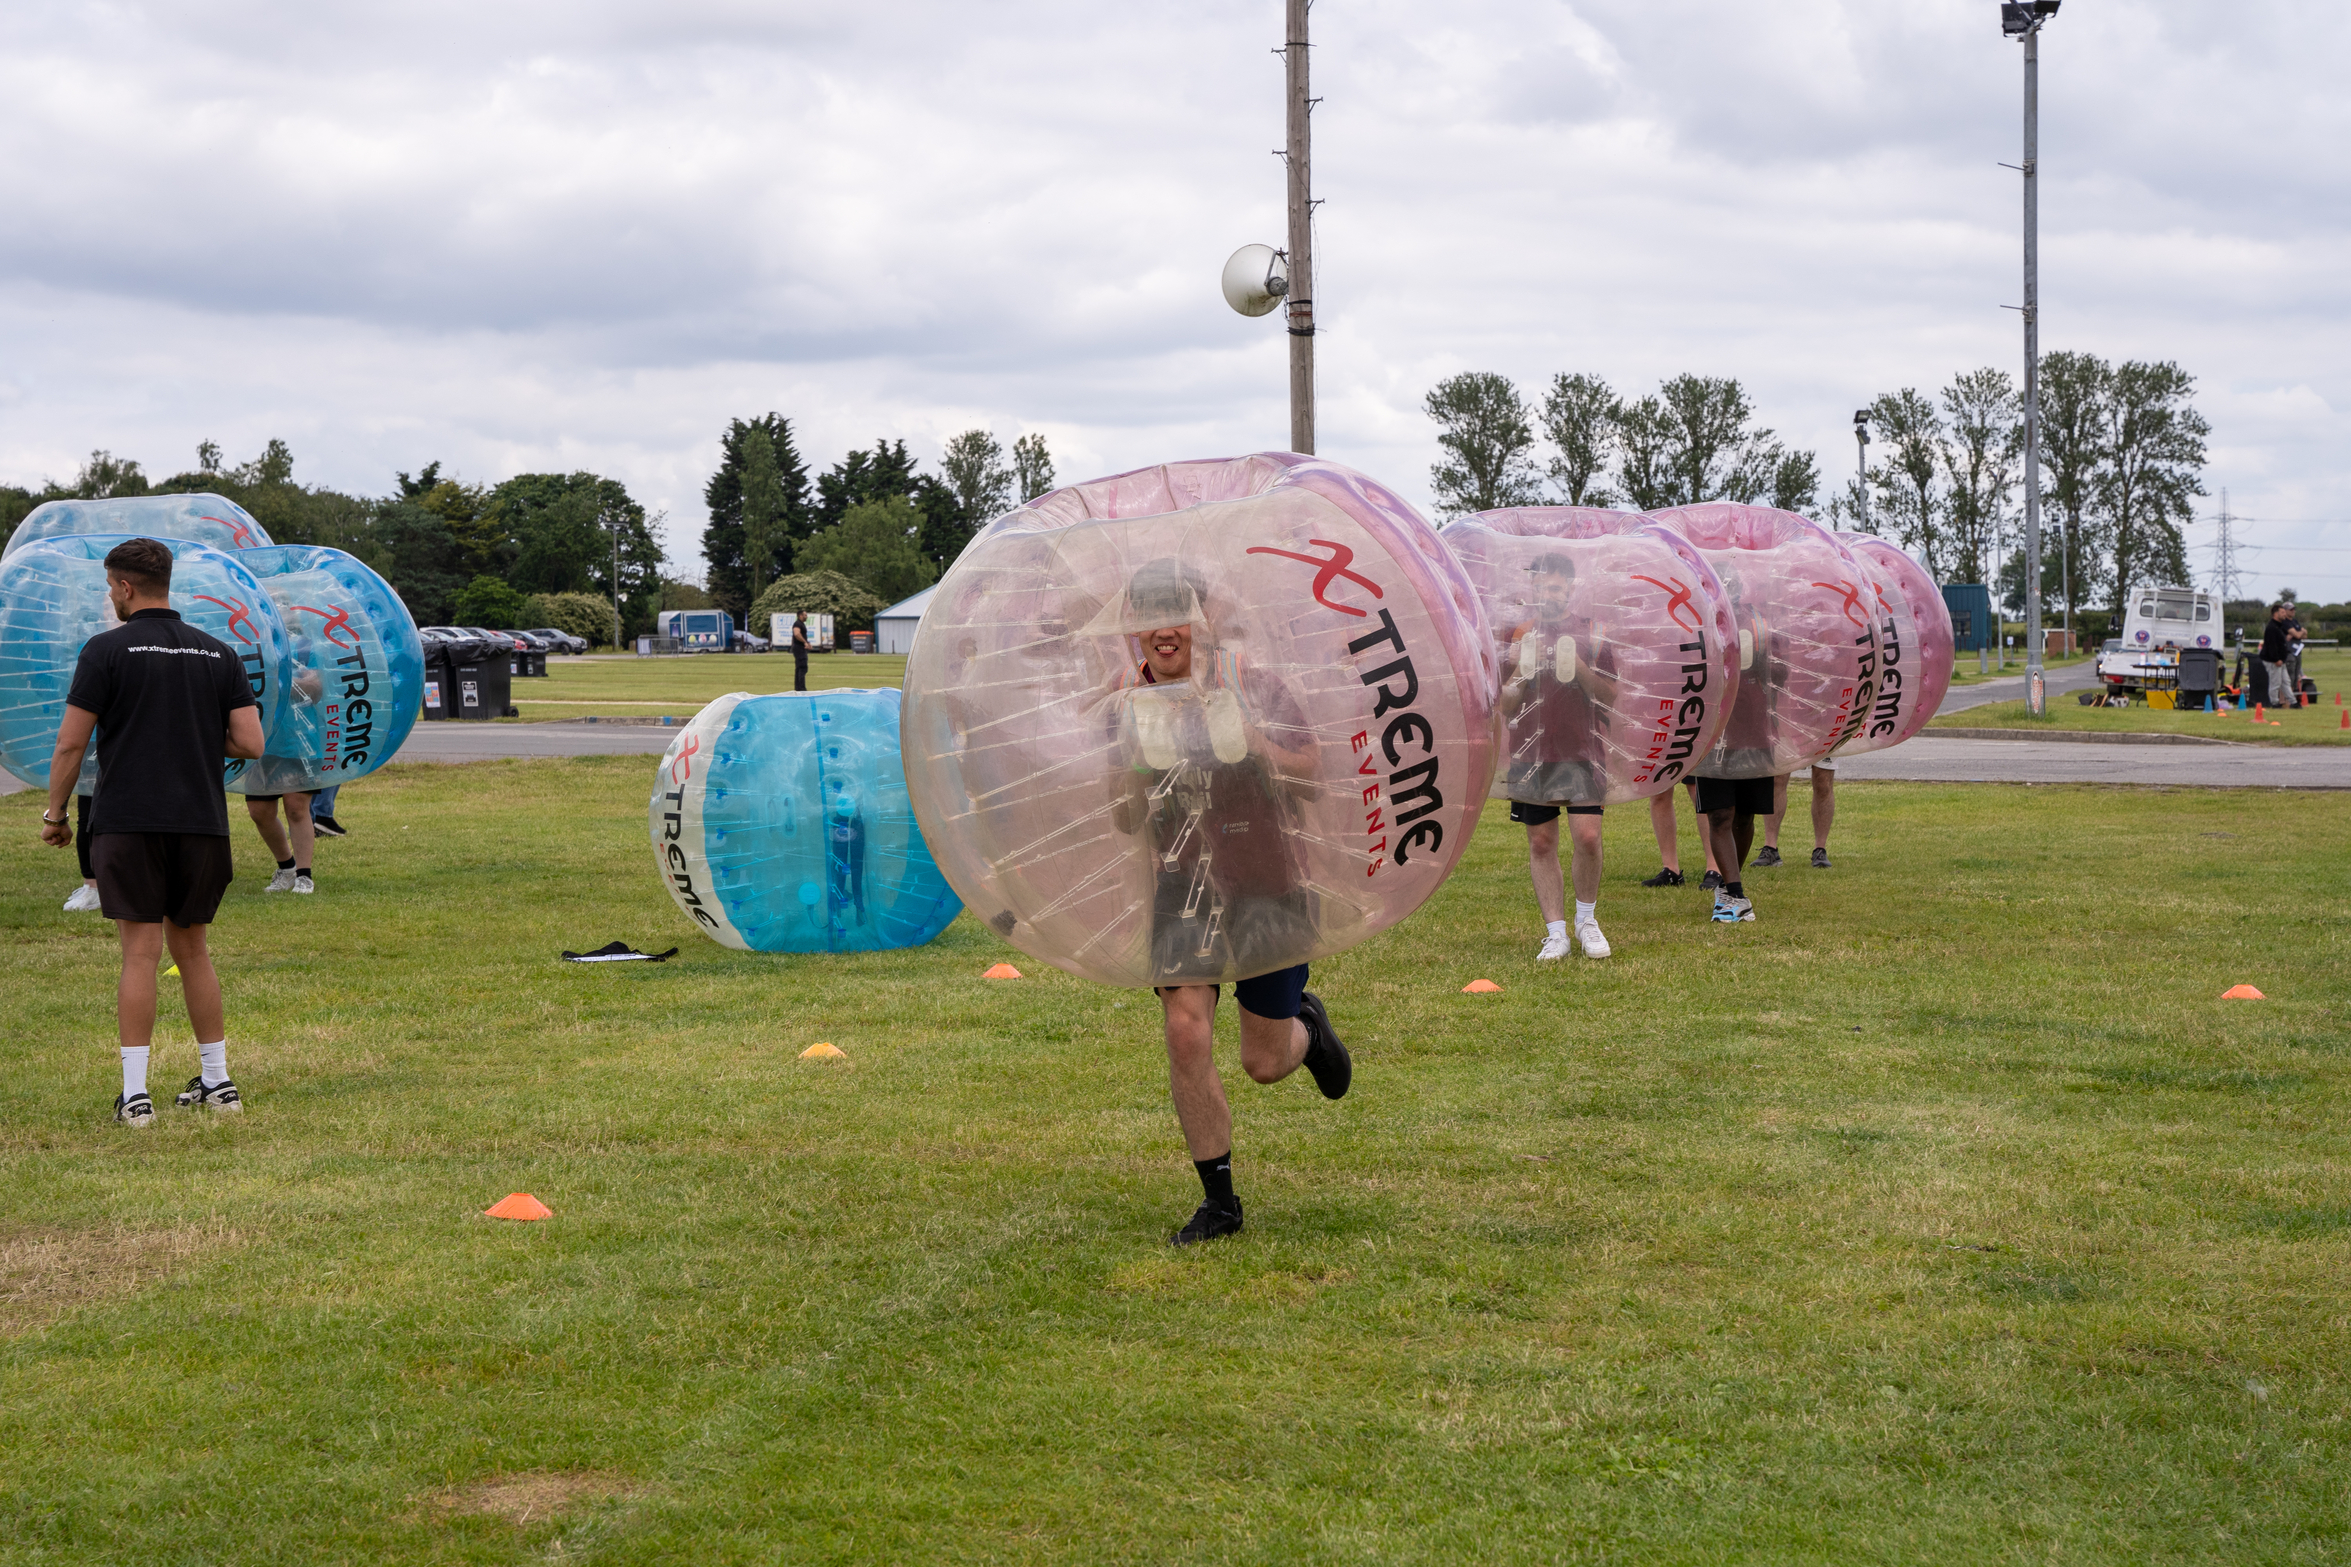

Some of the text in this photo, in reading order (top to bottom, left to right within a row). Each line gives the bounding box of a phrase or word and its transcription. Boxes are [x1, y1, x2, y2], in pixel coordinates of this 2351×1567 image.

[127, 645, 221, 658] www.xtremeevents.co.uk
[321, 704, 340, 772] EVENTS
[1633, 699, 1674, 783] EVENTS
[1814, 687, 1853, 756] EVENTS
[1350, 729, 1388, 878] EVENTS
